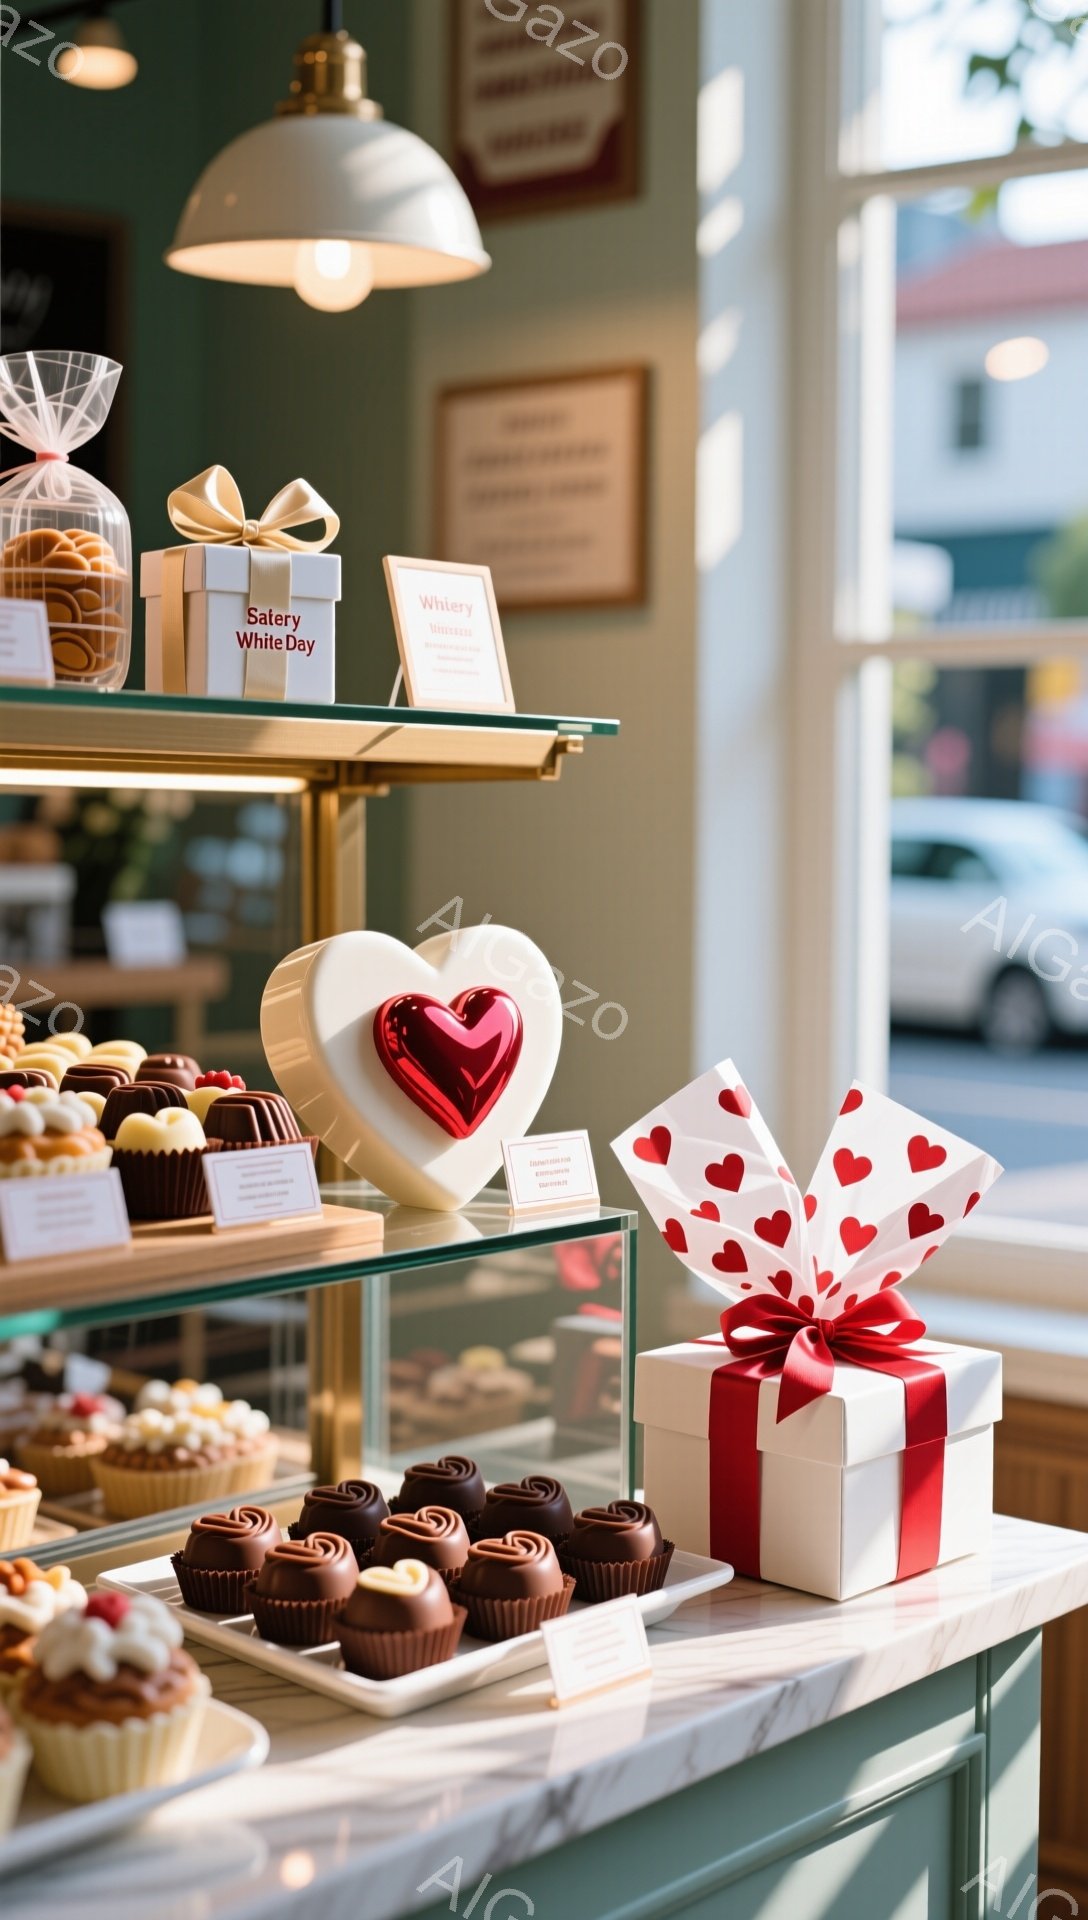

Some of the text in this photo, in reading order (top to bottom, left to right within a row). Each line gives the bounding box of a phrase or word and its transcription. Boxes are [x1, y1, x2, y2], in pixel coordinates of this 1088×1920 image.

[247, 607, 301, 632] Satery
[236, 631, 315, 657] White Day
